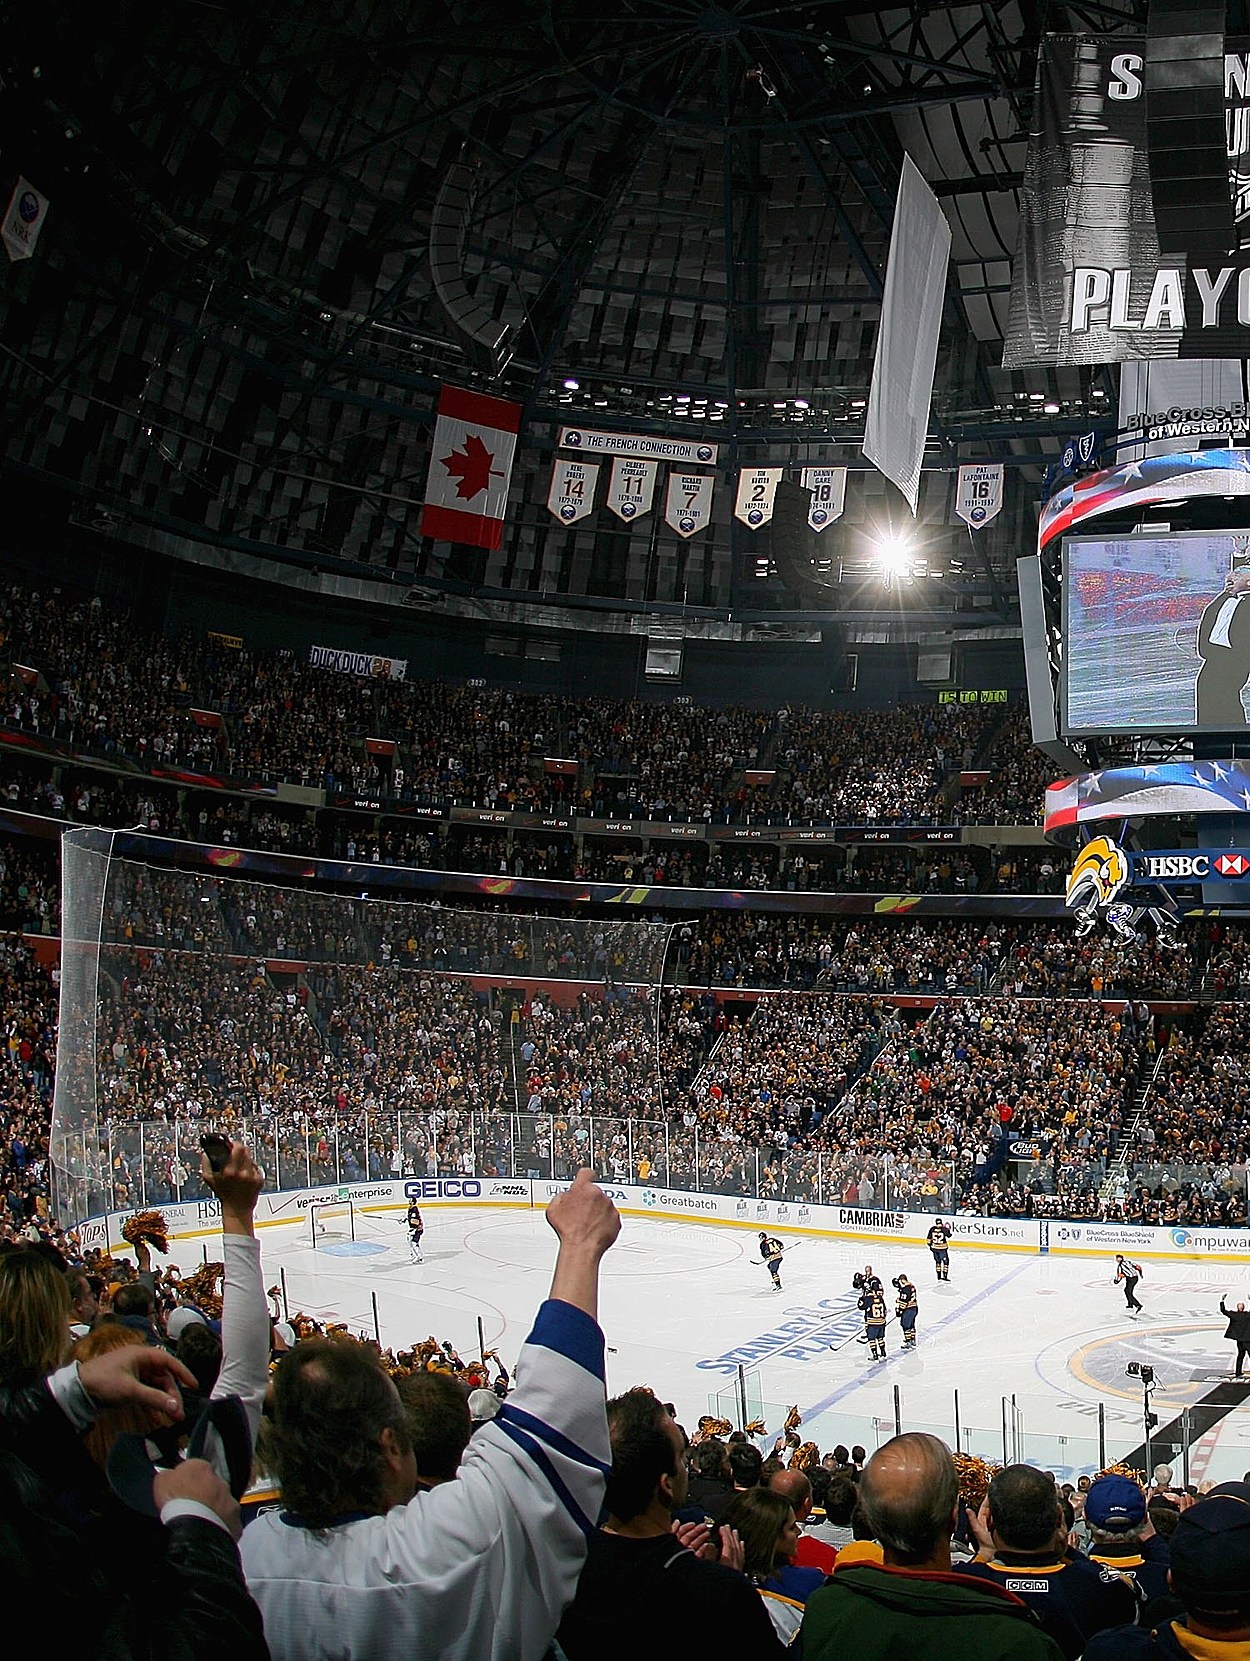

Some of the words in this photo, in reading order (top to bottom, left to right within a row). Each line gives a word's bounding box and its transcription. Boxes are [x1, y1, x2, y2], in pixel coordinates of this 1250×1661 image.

[1127, 403, 1226, 431] BlueCross
[1149, 426, 1166, 441] of
[1167, 420, 1233, 437] Western
[587, 435, 603, 447] THE
[605, 437, 637, 451] FRENCH
[640, 441, 691, 457] CONNECTION
[963, 472, 999, 481] LAFONTAINE
[563, 479, 584, 498] 14
[623, 477, 643, 495] 11
[753, 485, 764, 501] 2
[814, 484, 832, 502] 18
[972, 481, 989, 498] 16
[684, 492, 697, 509] 7
[311, 647, 341, 670] DUCK
[342, 652, 372, 675] DUCK
[961, 691, 977, 702] TO
[981, 691, 1007, 702] WIN
[1149, 856, 1209, 877] HSBC
[405, 1181, 481, 1198] GEICO
[660, 1194, 717, 1211] Greatbatch
[162, 1208, 186, 1218] ENERAL
[1086, 1229, 1119, 1237] BlueCross
[1121, 1230, 1155, 1239] BlueShield
[1094, 1236, 1121, 1244] Western
[696, 1317, 821, 1374] STANLEY
[1008, 1581, 1046, 1591] CCM
